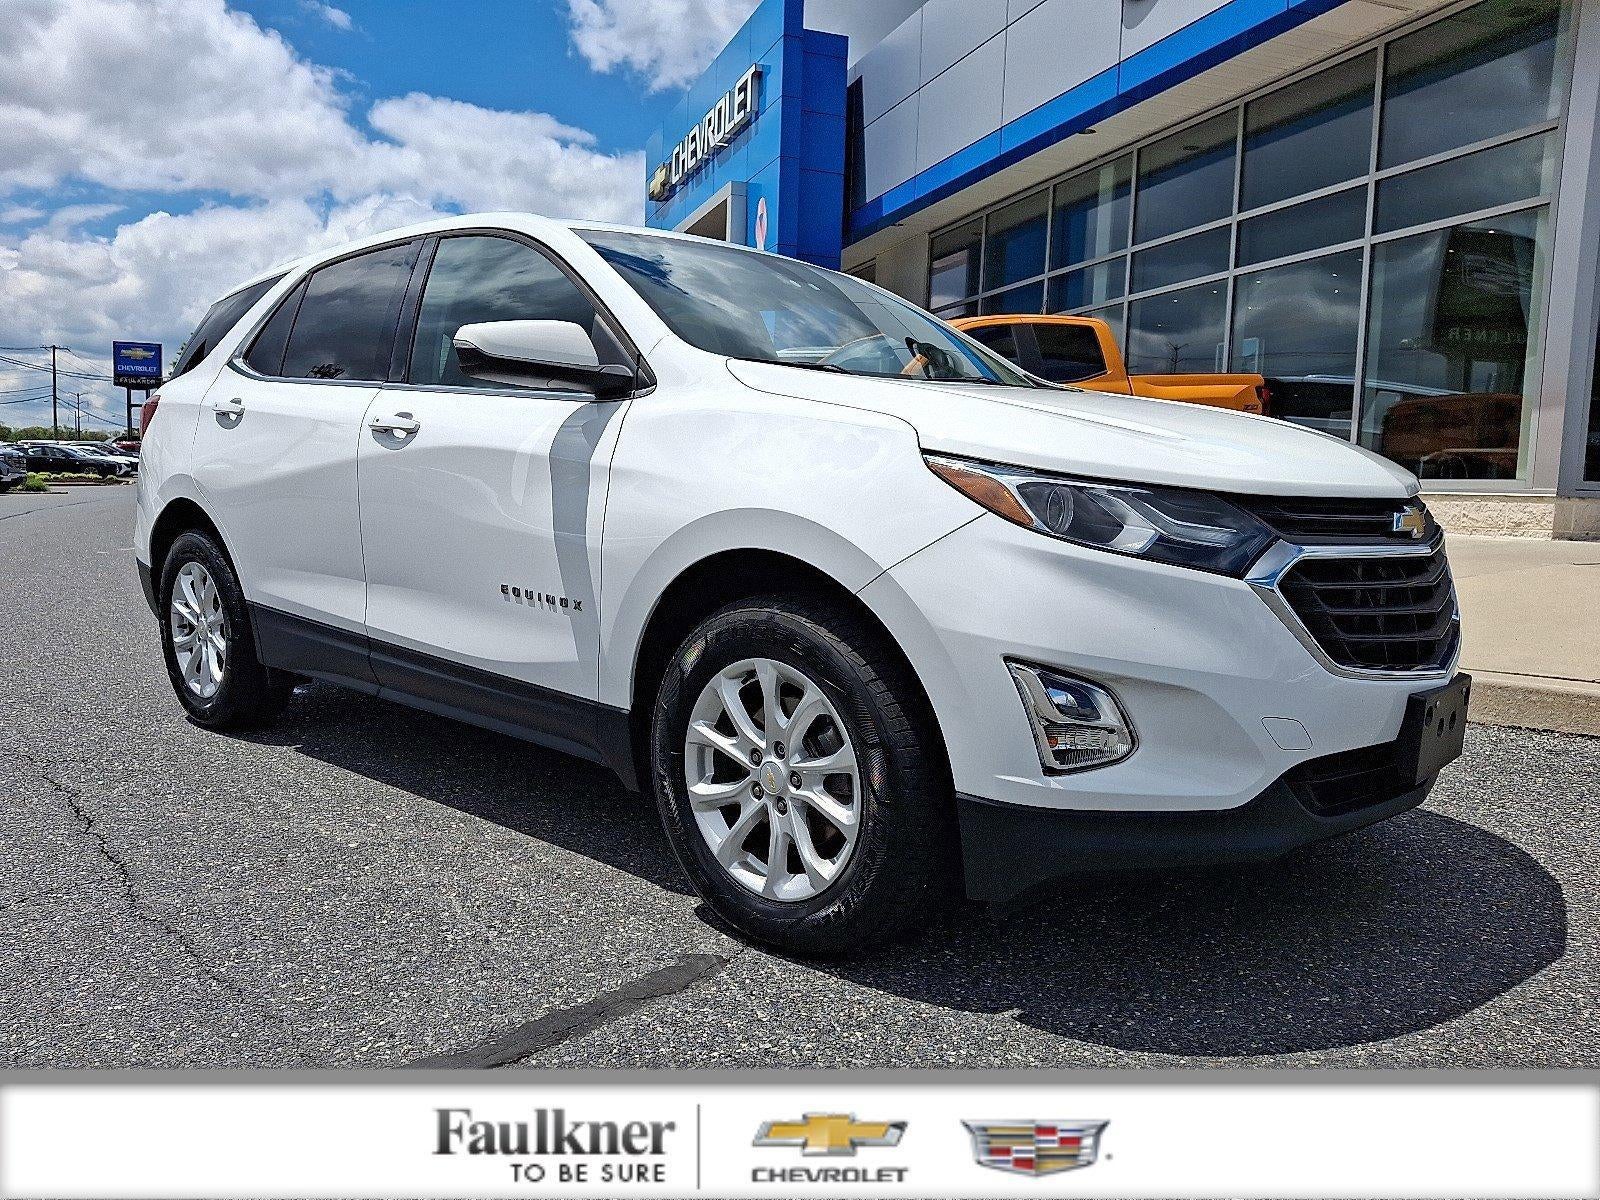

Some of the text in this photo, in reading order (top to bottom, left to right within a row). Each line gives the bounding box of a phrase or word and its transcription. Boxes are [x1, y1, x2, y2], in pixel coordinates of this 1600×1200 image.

[671, 62, 758, 185] CHEVROLET
[117, 364, 157, 372] CHEVROLET
[500, 584, 582, 611] EQUINOX
